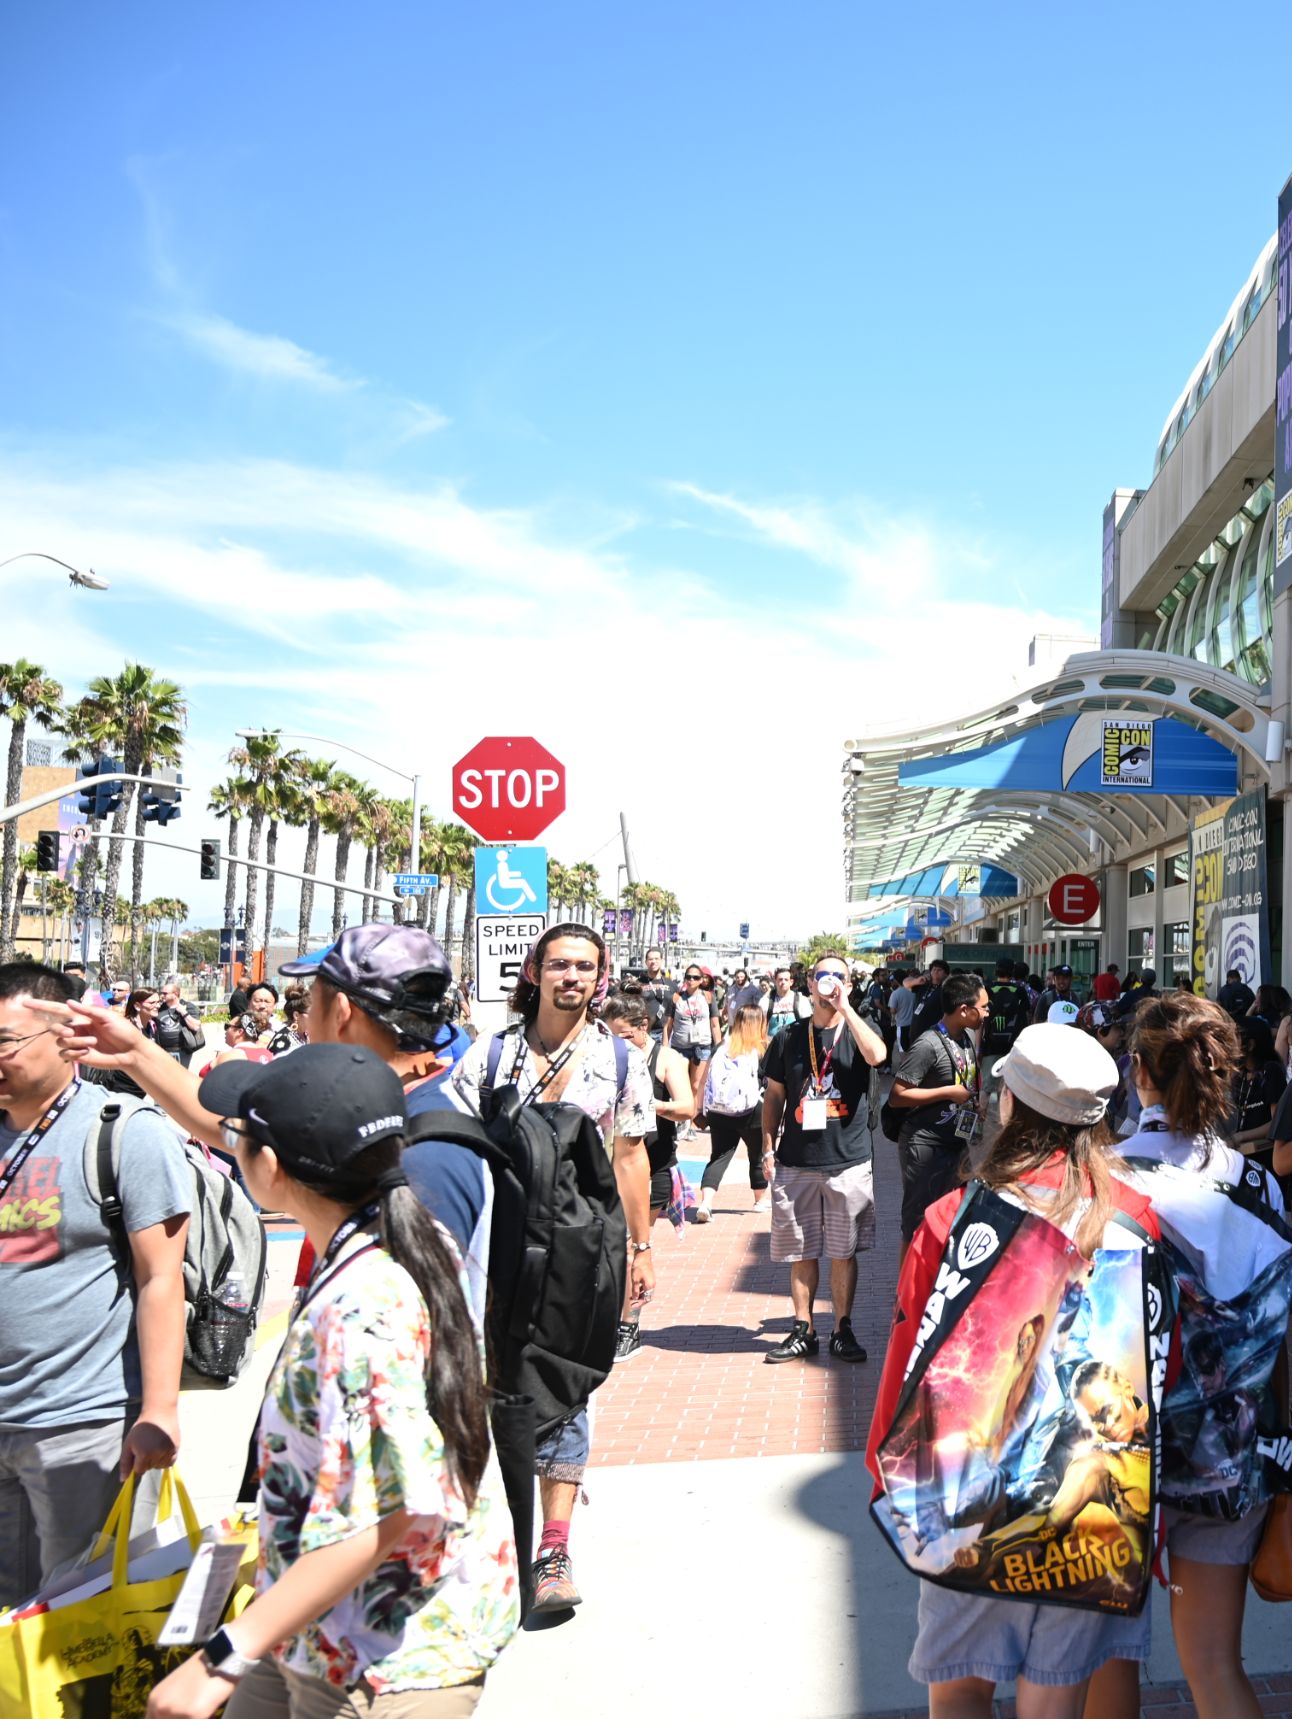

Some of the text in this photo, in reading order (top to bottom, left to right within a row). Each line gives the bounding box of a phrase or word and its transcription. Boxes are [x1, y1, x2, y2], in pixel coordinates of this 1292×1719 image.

[1103, 728, 1120, 776] COMIC
[1120, 729, 1151, 746] CON
[458, 768, 560, 809] STOP
[1102, 775, 1151, 784] INTERNATIONAL
[1063, 885, 1085, 914] E
[482, 924, 539, 938] SPEED
[1040, 1527, 1057, 1540] DC
[989, 1536, 1132, 1592] LIGHTNING
[1003, 1526, 1105, 1578] BLACK
